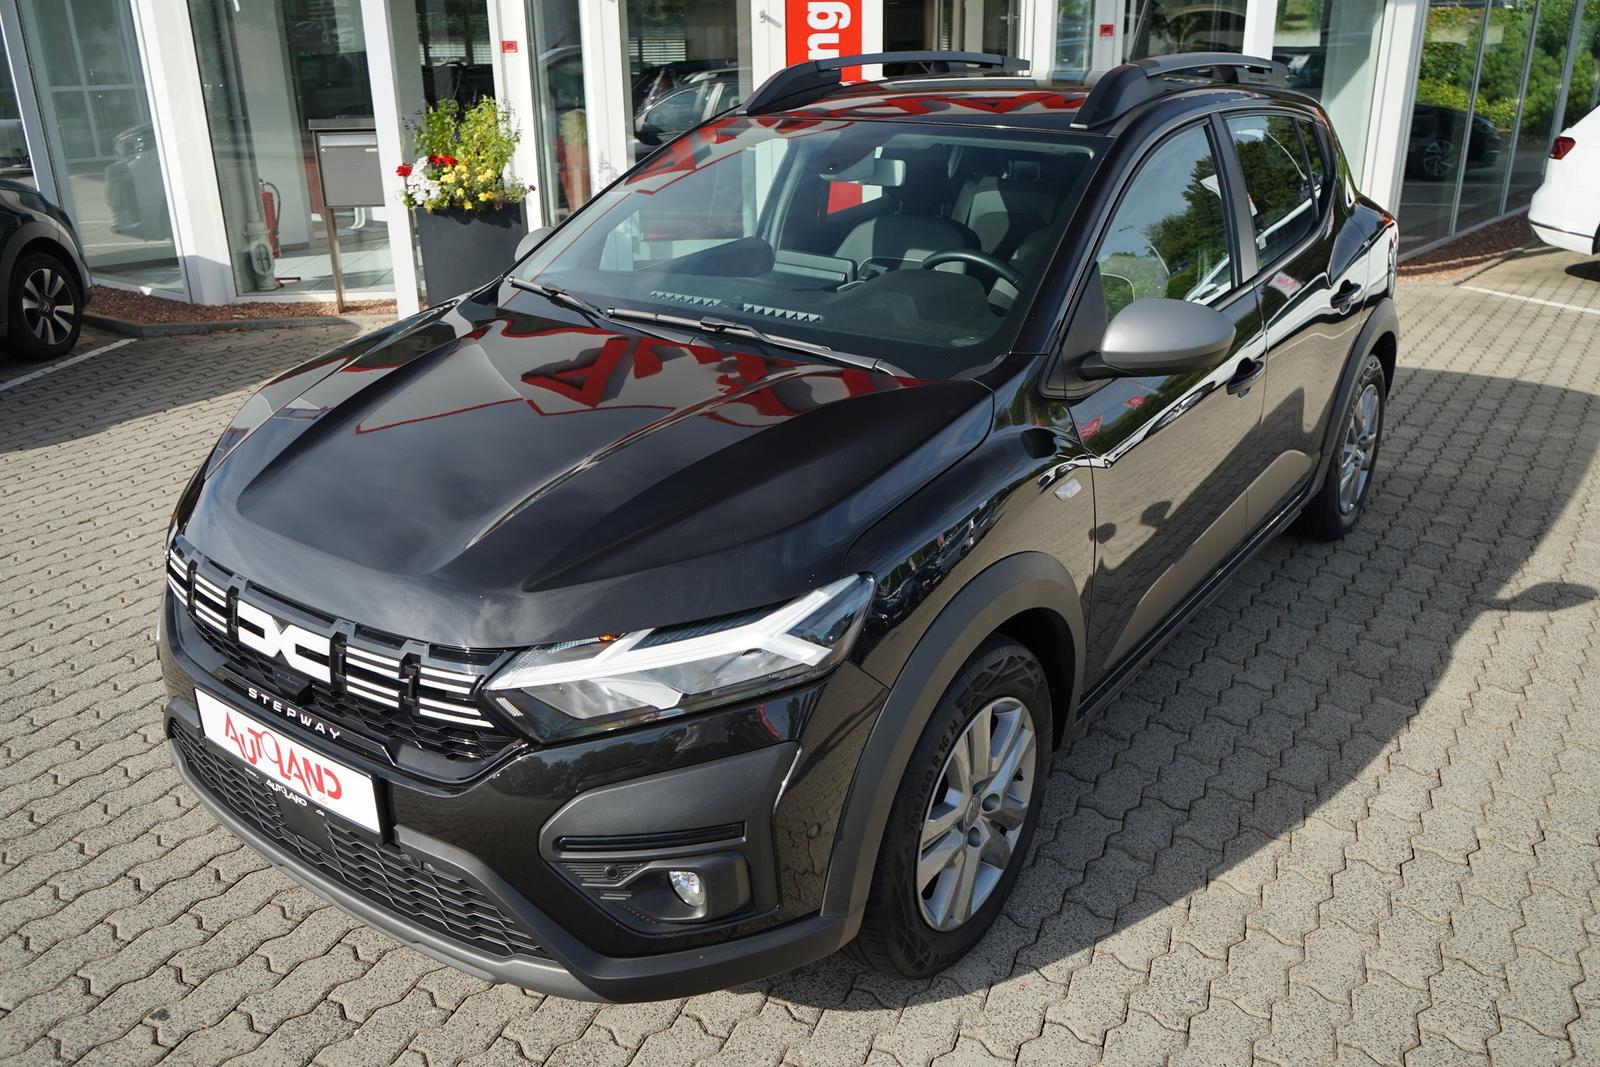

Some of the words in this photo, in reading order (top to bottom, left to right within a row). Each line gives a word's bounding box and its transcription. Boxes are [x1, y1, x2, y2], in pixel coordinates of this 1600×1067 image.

[807, 1, 851, 60] ng
[248, 687, 341, 739] STEPWAY
[225, 711, 342, 800] AUTOLAND
